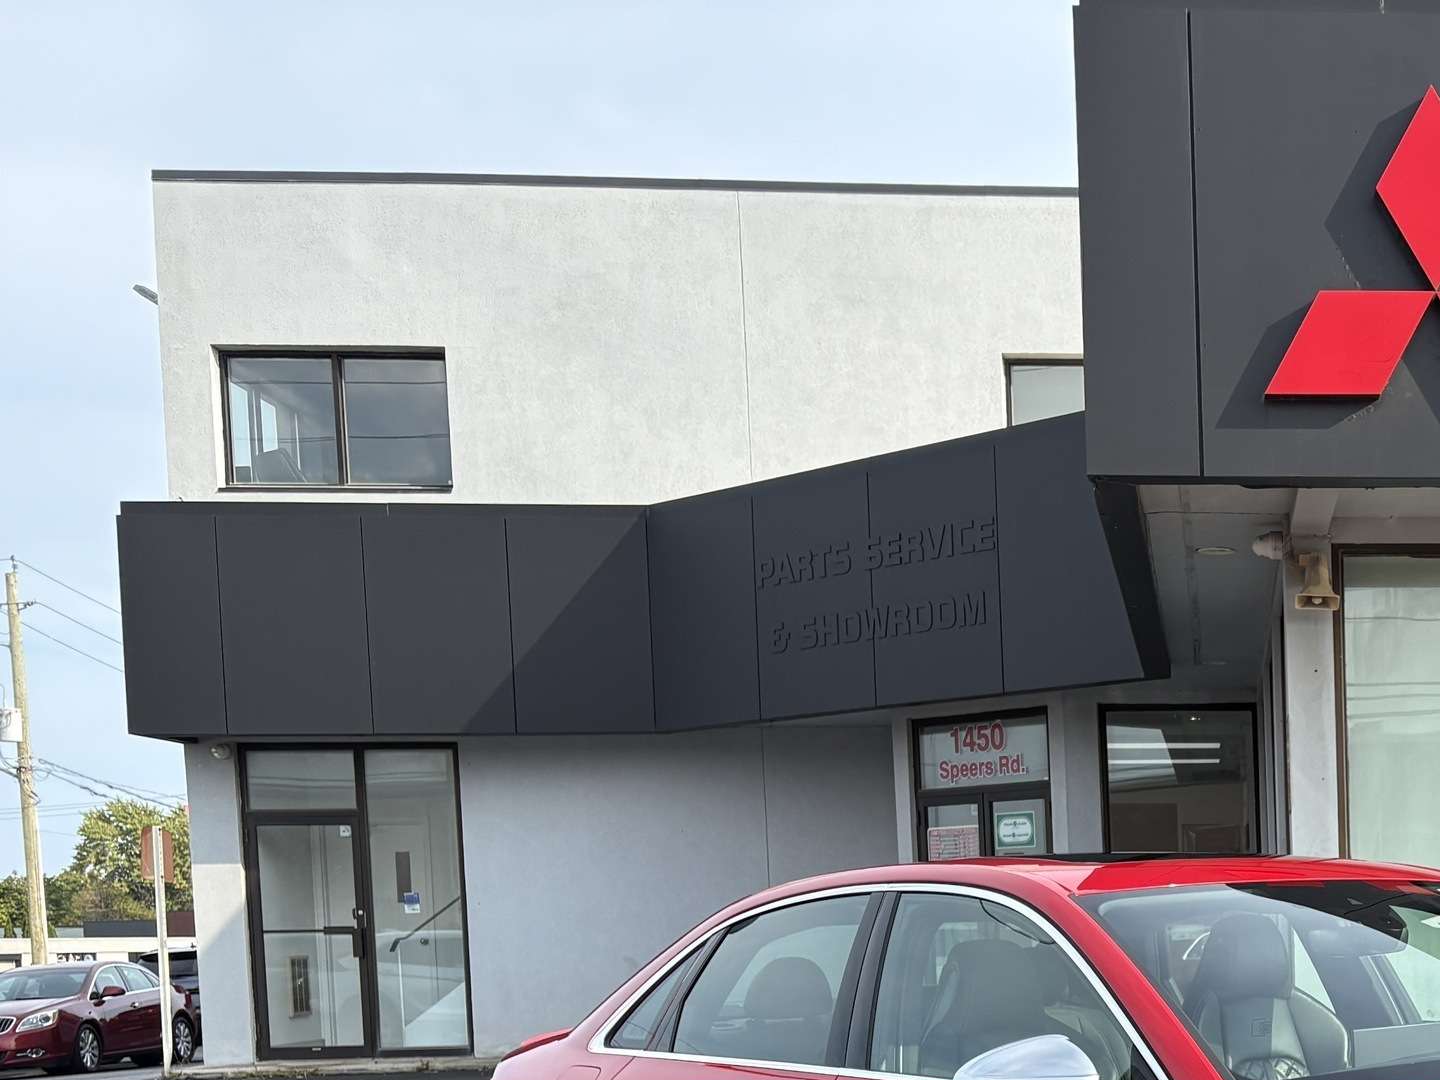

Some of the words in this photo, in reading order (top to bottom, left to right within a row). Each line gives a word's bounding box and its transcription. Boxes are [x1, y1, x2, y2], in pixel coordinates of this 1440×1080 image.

[756, 541, 852, 590] PARTS
[863, 516, 996, 573] SERVICE
[770, 621, 791, 655] &
[799, 591, 988, 652] SHOWROOM
[949, 720, 1007, 754] 1450
[939, 759, 994, 785] Speers
[998, 753, 1027, 776] Rd.
